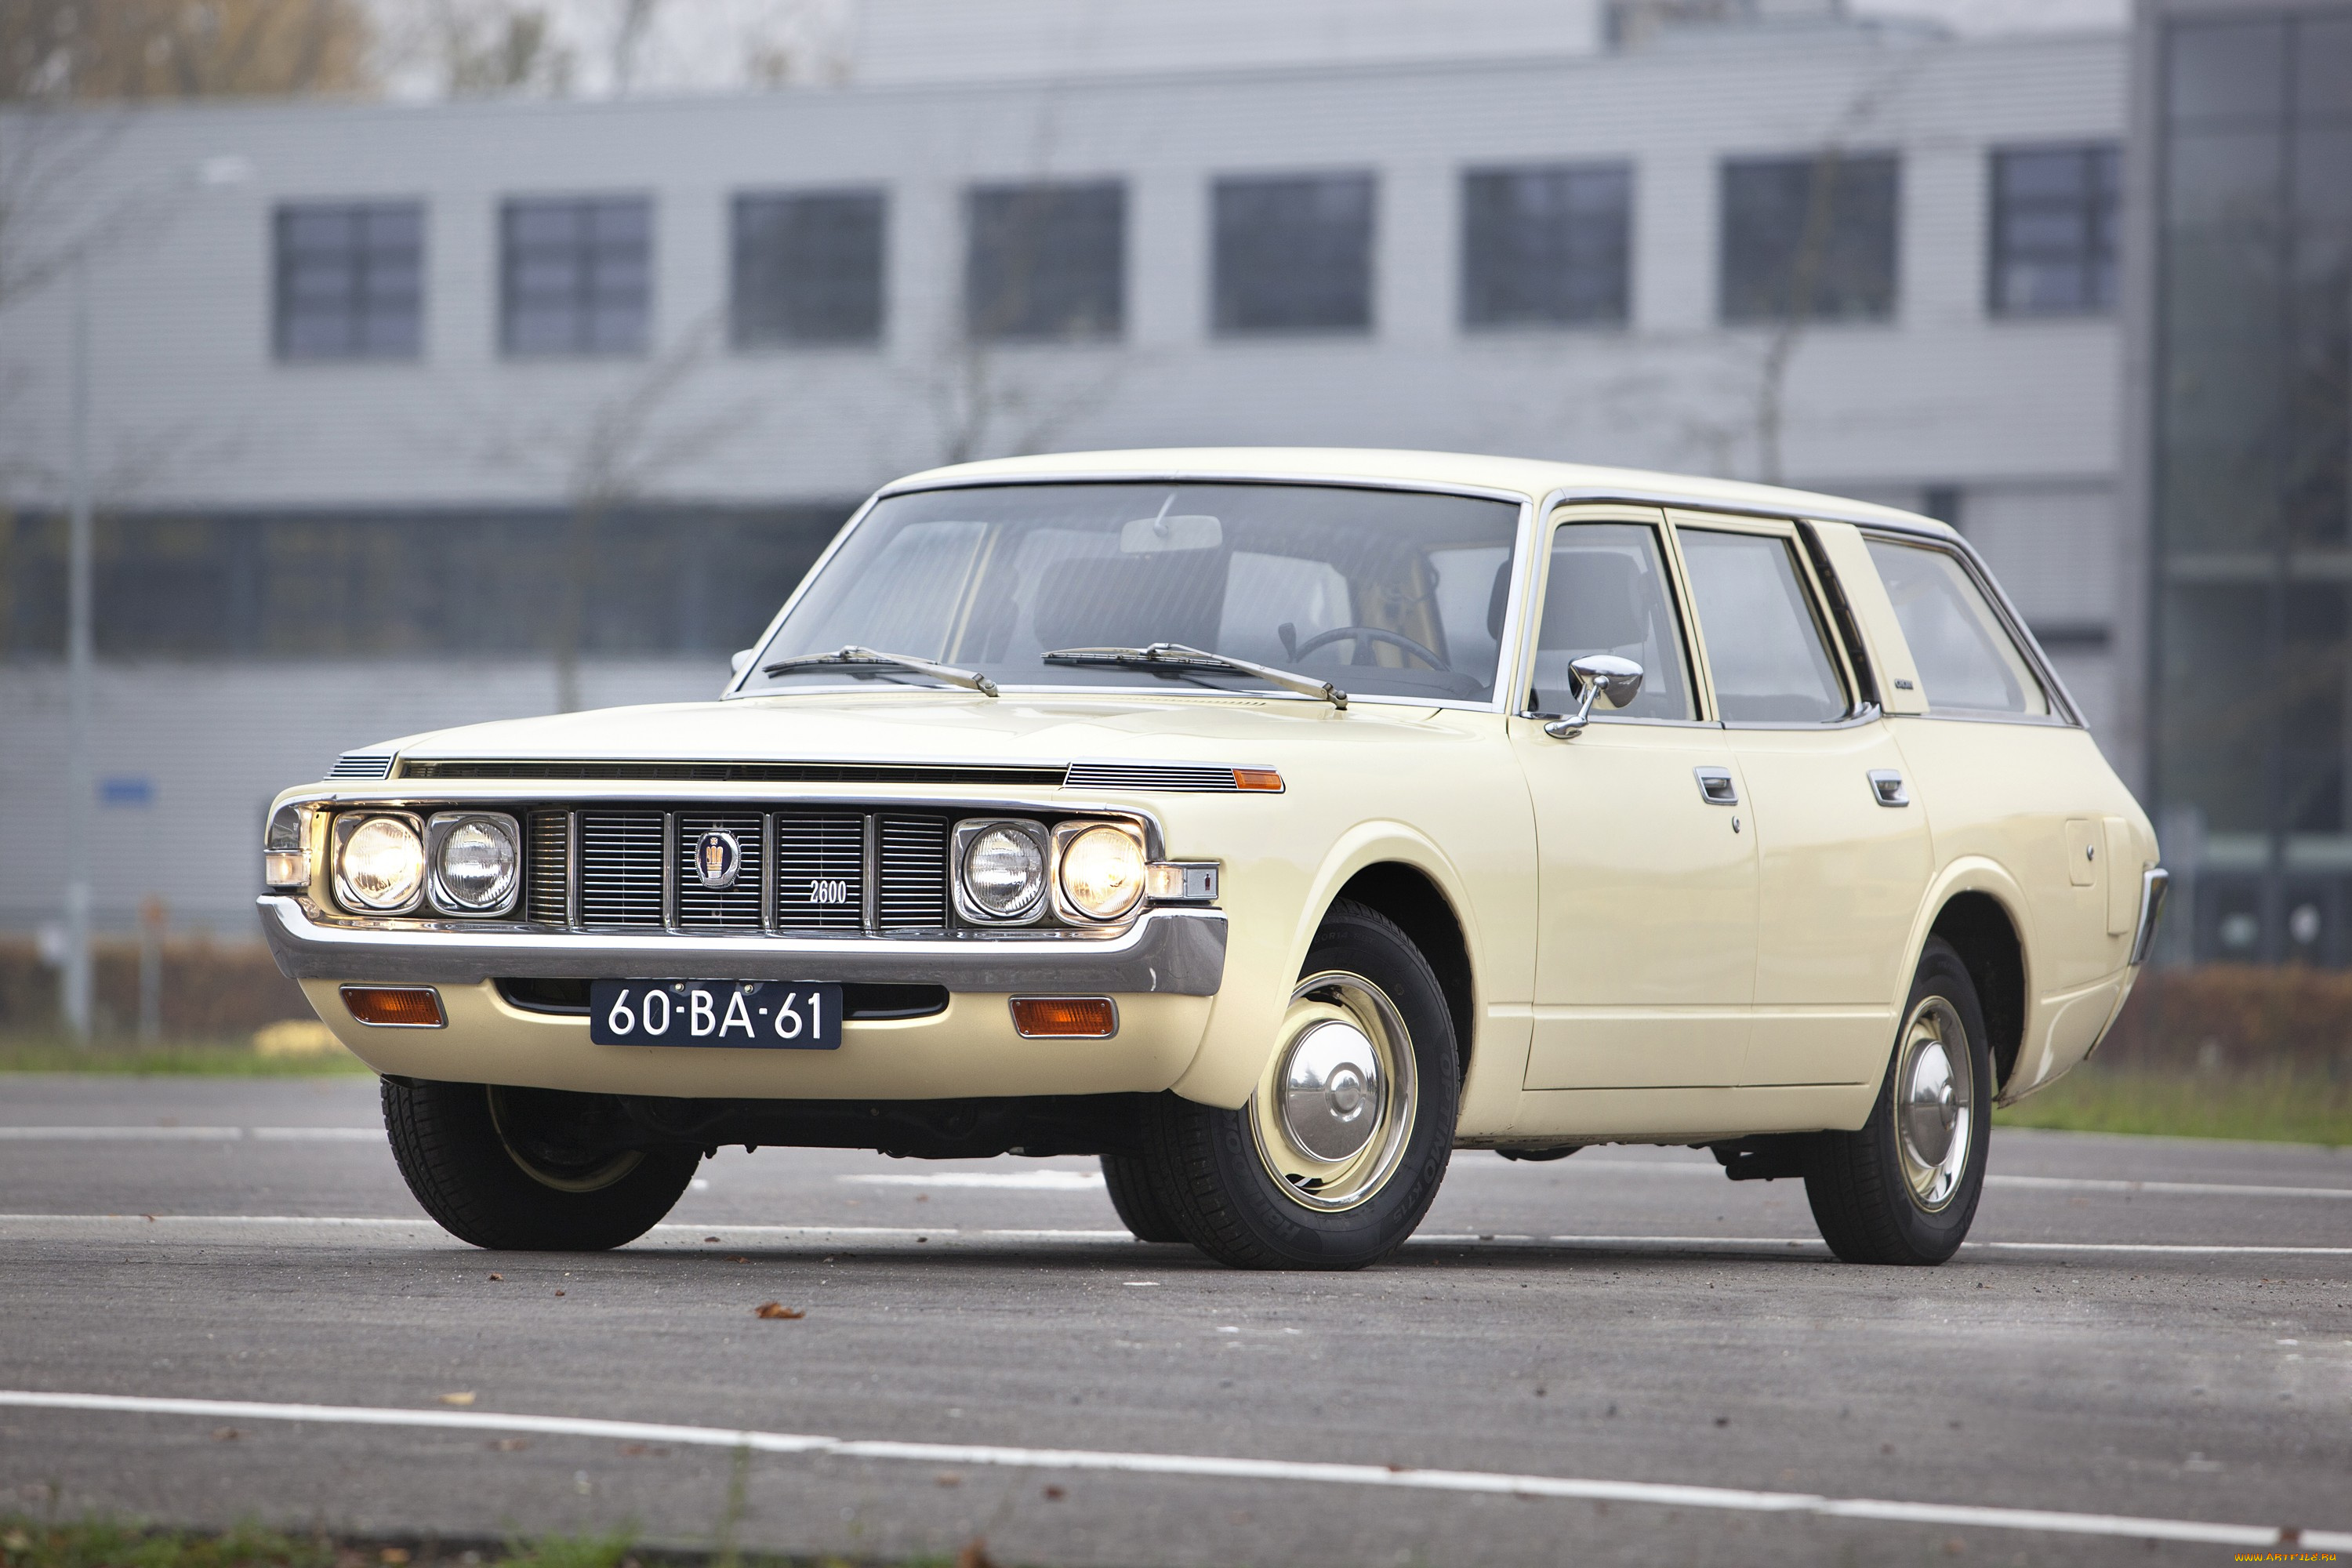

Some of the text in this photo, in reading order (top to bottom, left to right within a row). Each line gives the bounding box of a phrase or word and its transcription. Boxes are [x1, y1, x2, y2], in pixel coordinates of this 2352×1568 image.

[810, 880, 846, 904] 2600
[608, 989, 820, 1040] 60-BA-61
[1392, 1051, 1454, 1225] OPTIMO K715
